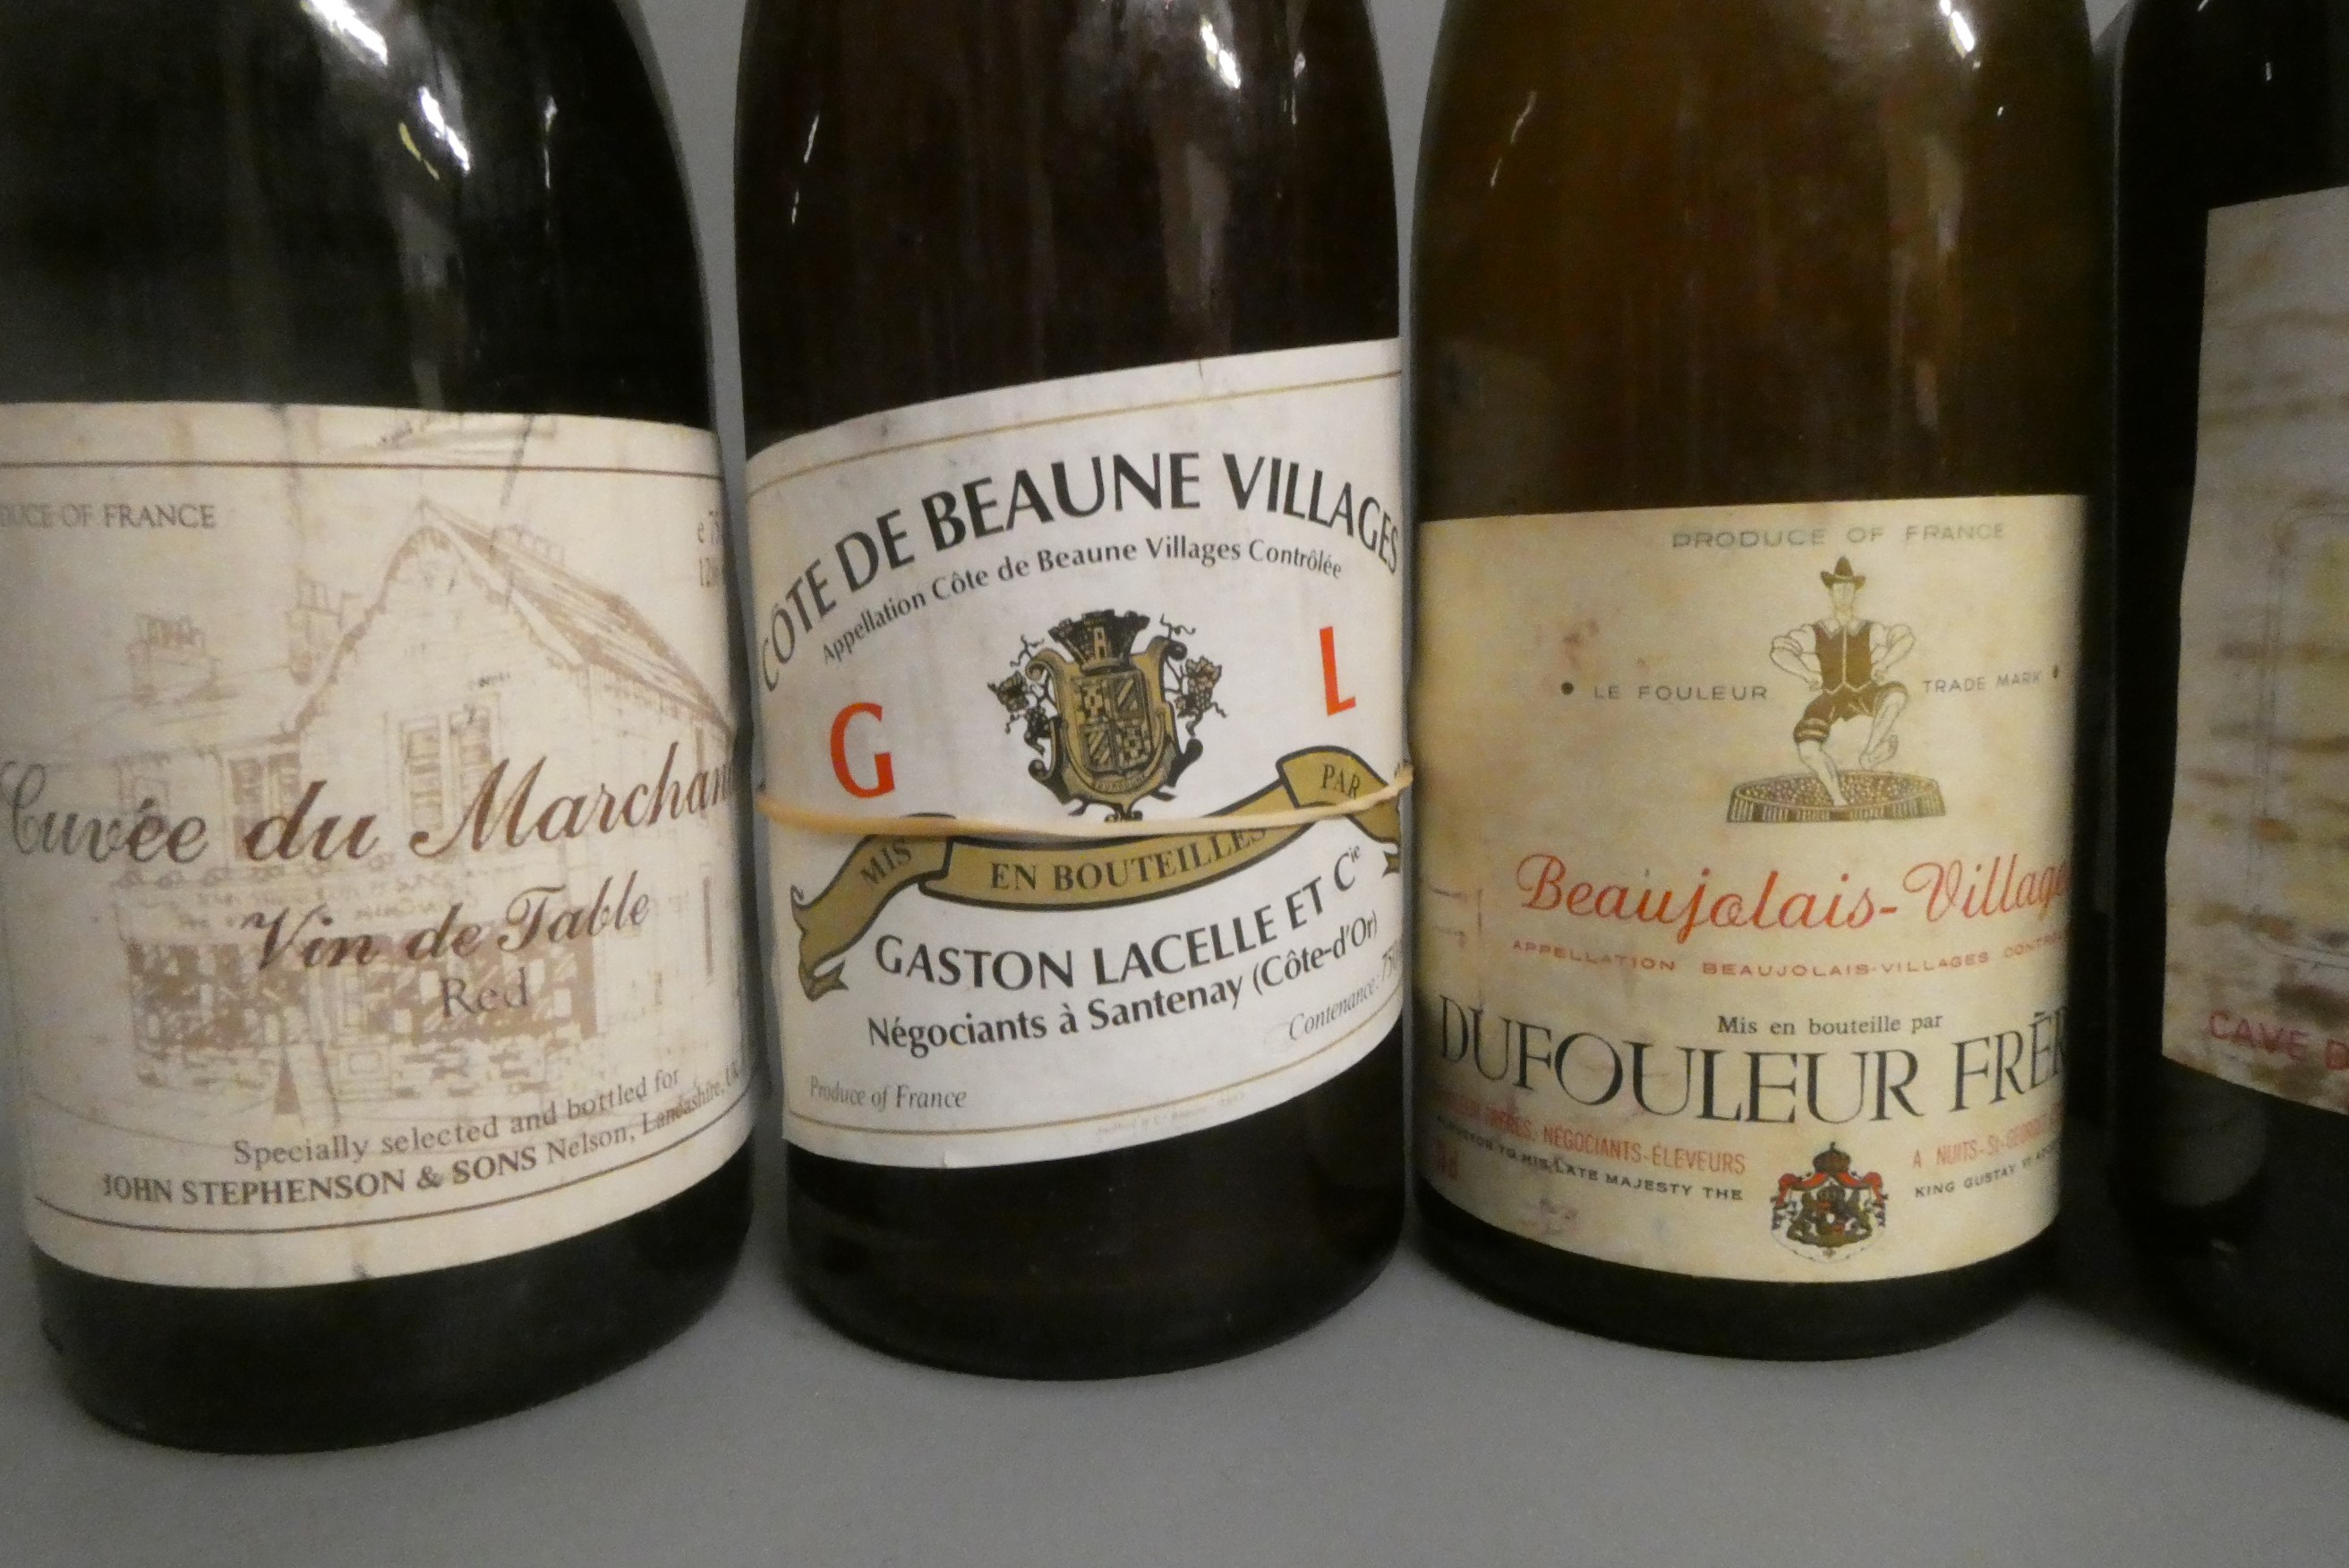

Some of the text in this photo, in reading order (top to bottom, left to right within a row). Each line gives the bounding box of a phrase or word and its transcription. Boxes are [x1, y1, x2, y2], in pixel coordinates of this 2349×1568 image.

[59, 503, 93, 528] OF
[101, 503, 217, 528] FRANCE
[1671, 522, 2004, 549] PRODUCE OF FRANCE
[762, 452, 1398, 692] CÔTE DE BEAUNE VILLAGES
[822, 534, 1343, 666] Appellation Côte de Beaune Villages Contrôlée
[1319, 626, 1357, 716] L
[1593, 686, 1621, 700] LE
[1637, 685, 1768, 701] FOULEUR
[1921, 676, 1986, 694] TRADE
[830, 702, 895, 798] G
[1320, 763, 1361, 801] PAR
[0, 760, 209, 864] Cuvée
[243, 779, 380, 863] du
[859, 839, 912, 886] MIS
[990, 861, 1037, 891] EN
[241, 870, 650, 971] Vin de Table
[876, 934, 1075, 991] GASTON
[1092, 904, 1278, 986] LACELLE
[1285, 875, 1324, 932] ET
[1512, 939, 1677, 972] APPELLATION
[441, 966, 528, 1018] Red
[867, 908, 1378, 1059] Négociants à Santenay (Côte-d'Or)
[1716, 1014, 1943, 1036] Mis en bouteille par
[2208, 1009, 2310, 1061] CAVE
[1439, 994, 1926, 1125] DUFOULEUR
[809, 1074, 968, 1113] Produce of France
[234, 1069, 679, 1171] Specially selected and bottled for
[103, 1172, 173, 1203] JOHN
[182, 1168, 406, 1206] STEPHENSON
[416, 1165, 443, 1191] &
[452, 1146, 537, 1186] SONS
[546, 1123, 636, 1165] Nelson,
[1604, 1172, 1693, 1197] MAJESTY
[1704, 1186, 1744, 1201] THE
[1914, 1180, 1956, 1198] KING
